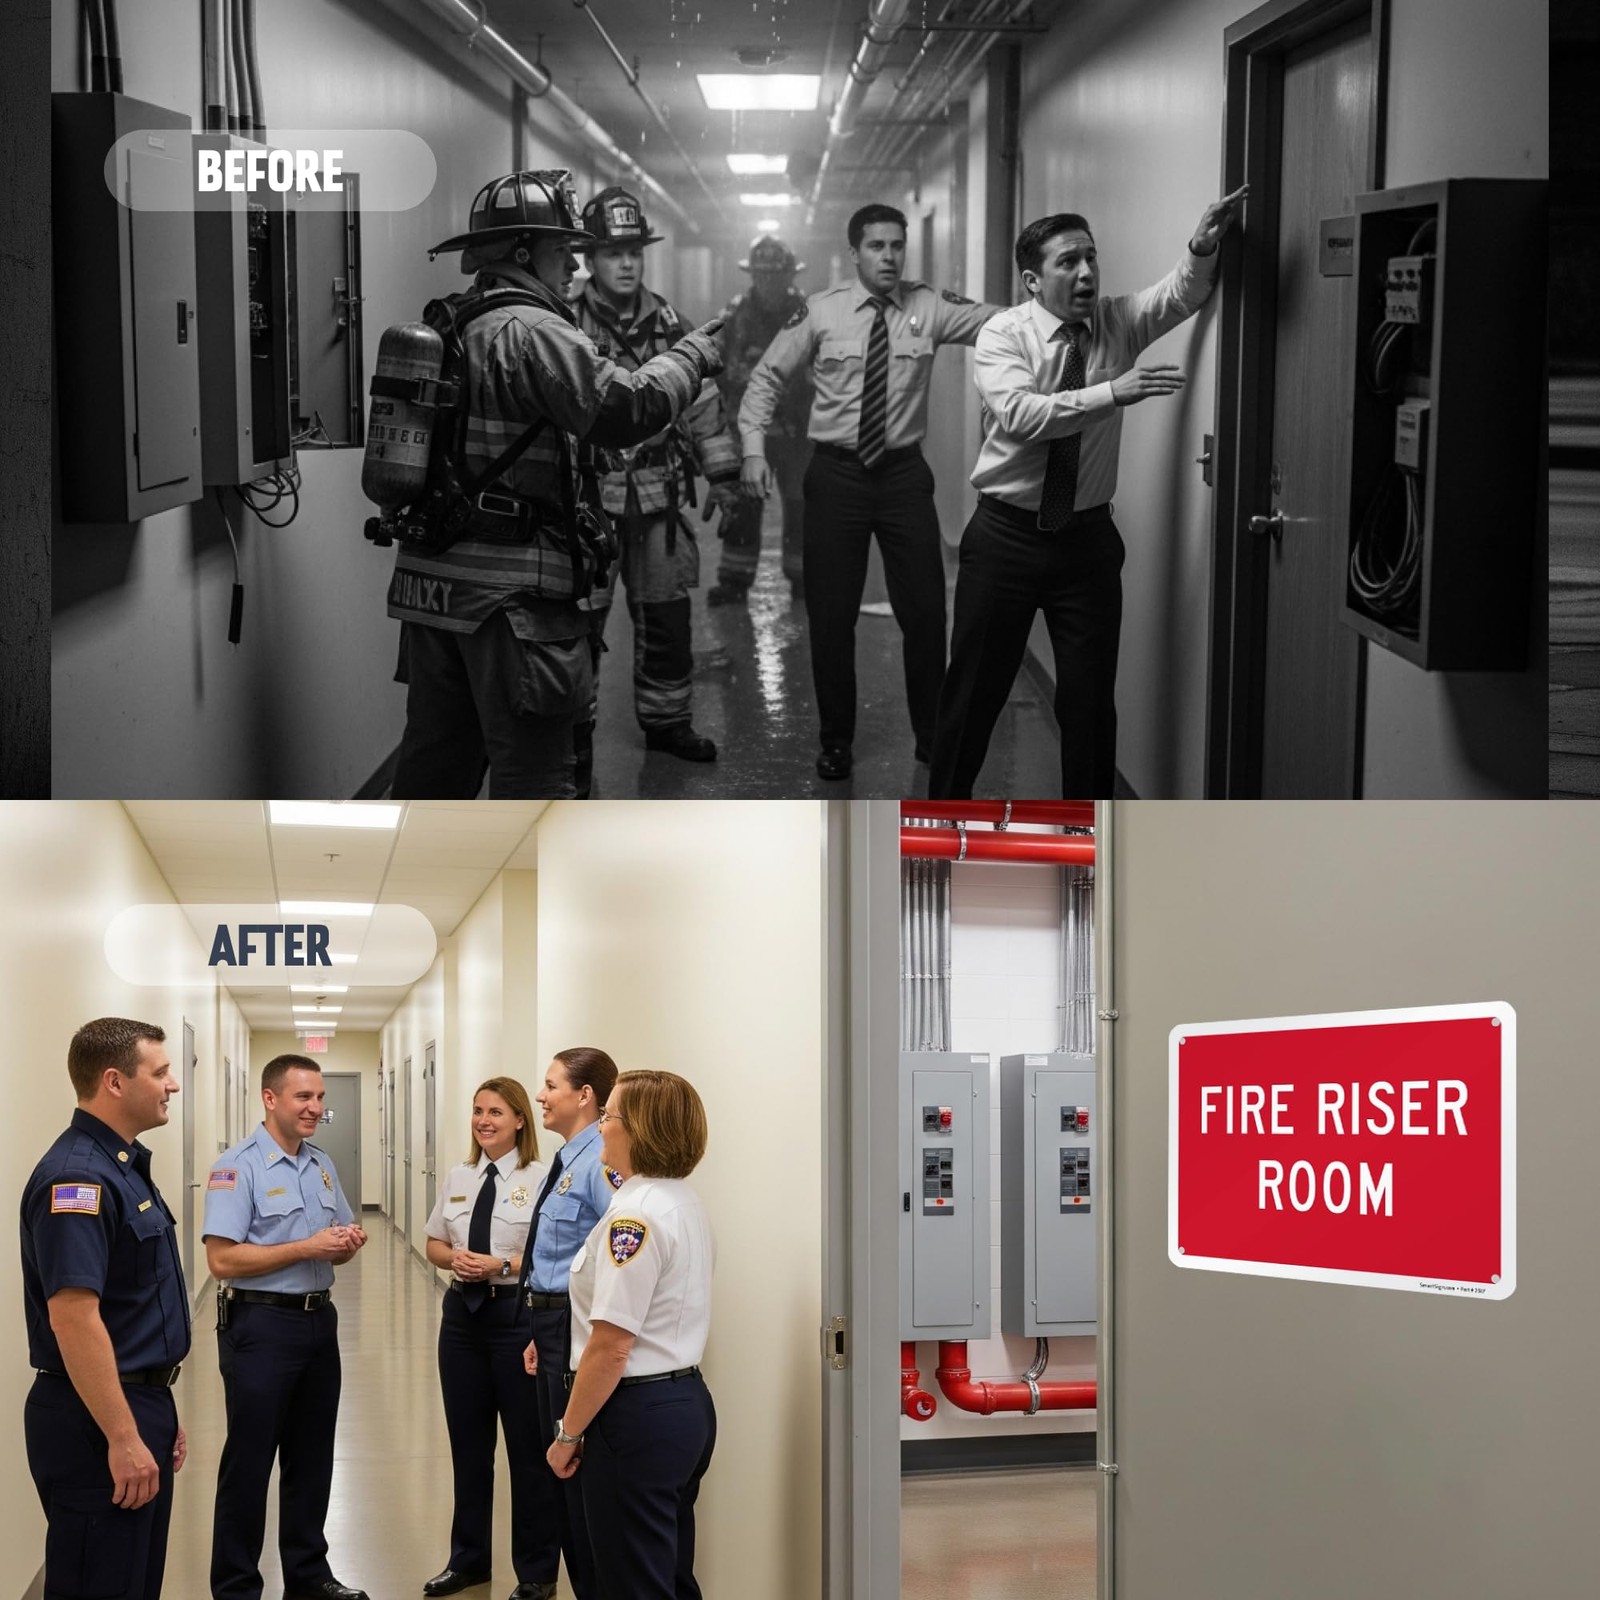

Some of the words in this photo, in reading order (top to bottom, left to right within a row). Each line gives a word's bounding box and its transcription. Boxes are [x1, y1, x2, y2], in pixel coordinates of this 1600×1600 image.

[1201, 1084, 1294, 1135] FIRE
[1318, 1080, 1468, 1136] RISER
[1258, 1160, 1393, 1217] ROOM
